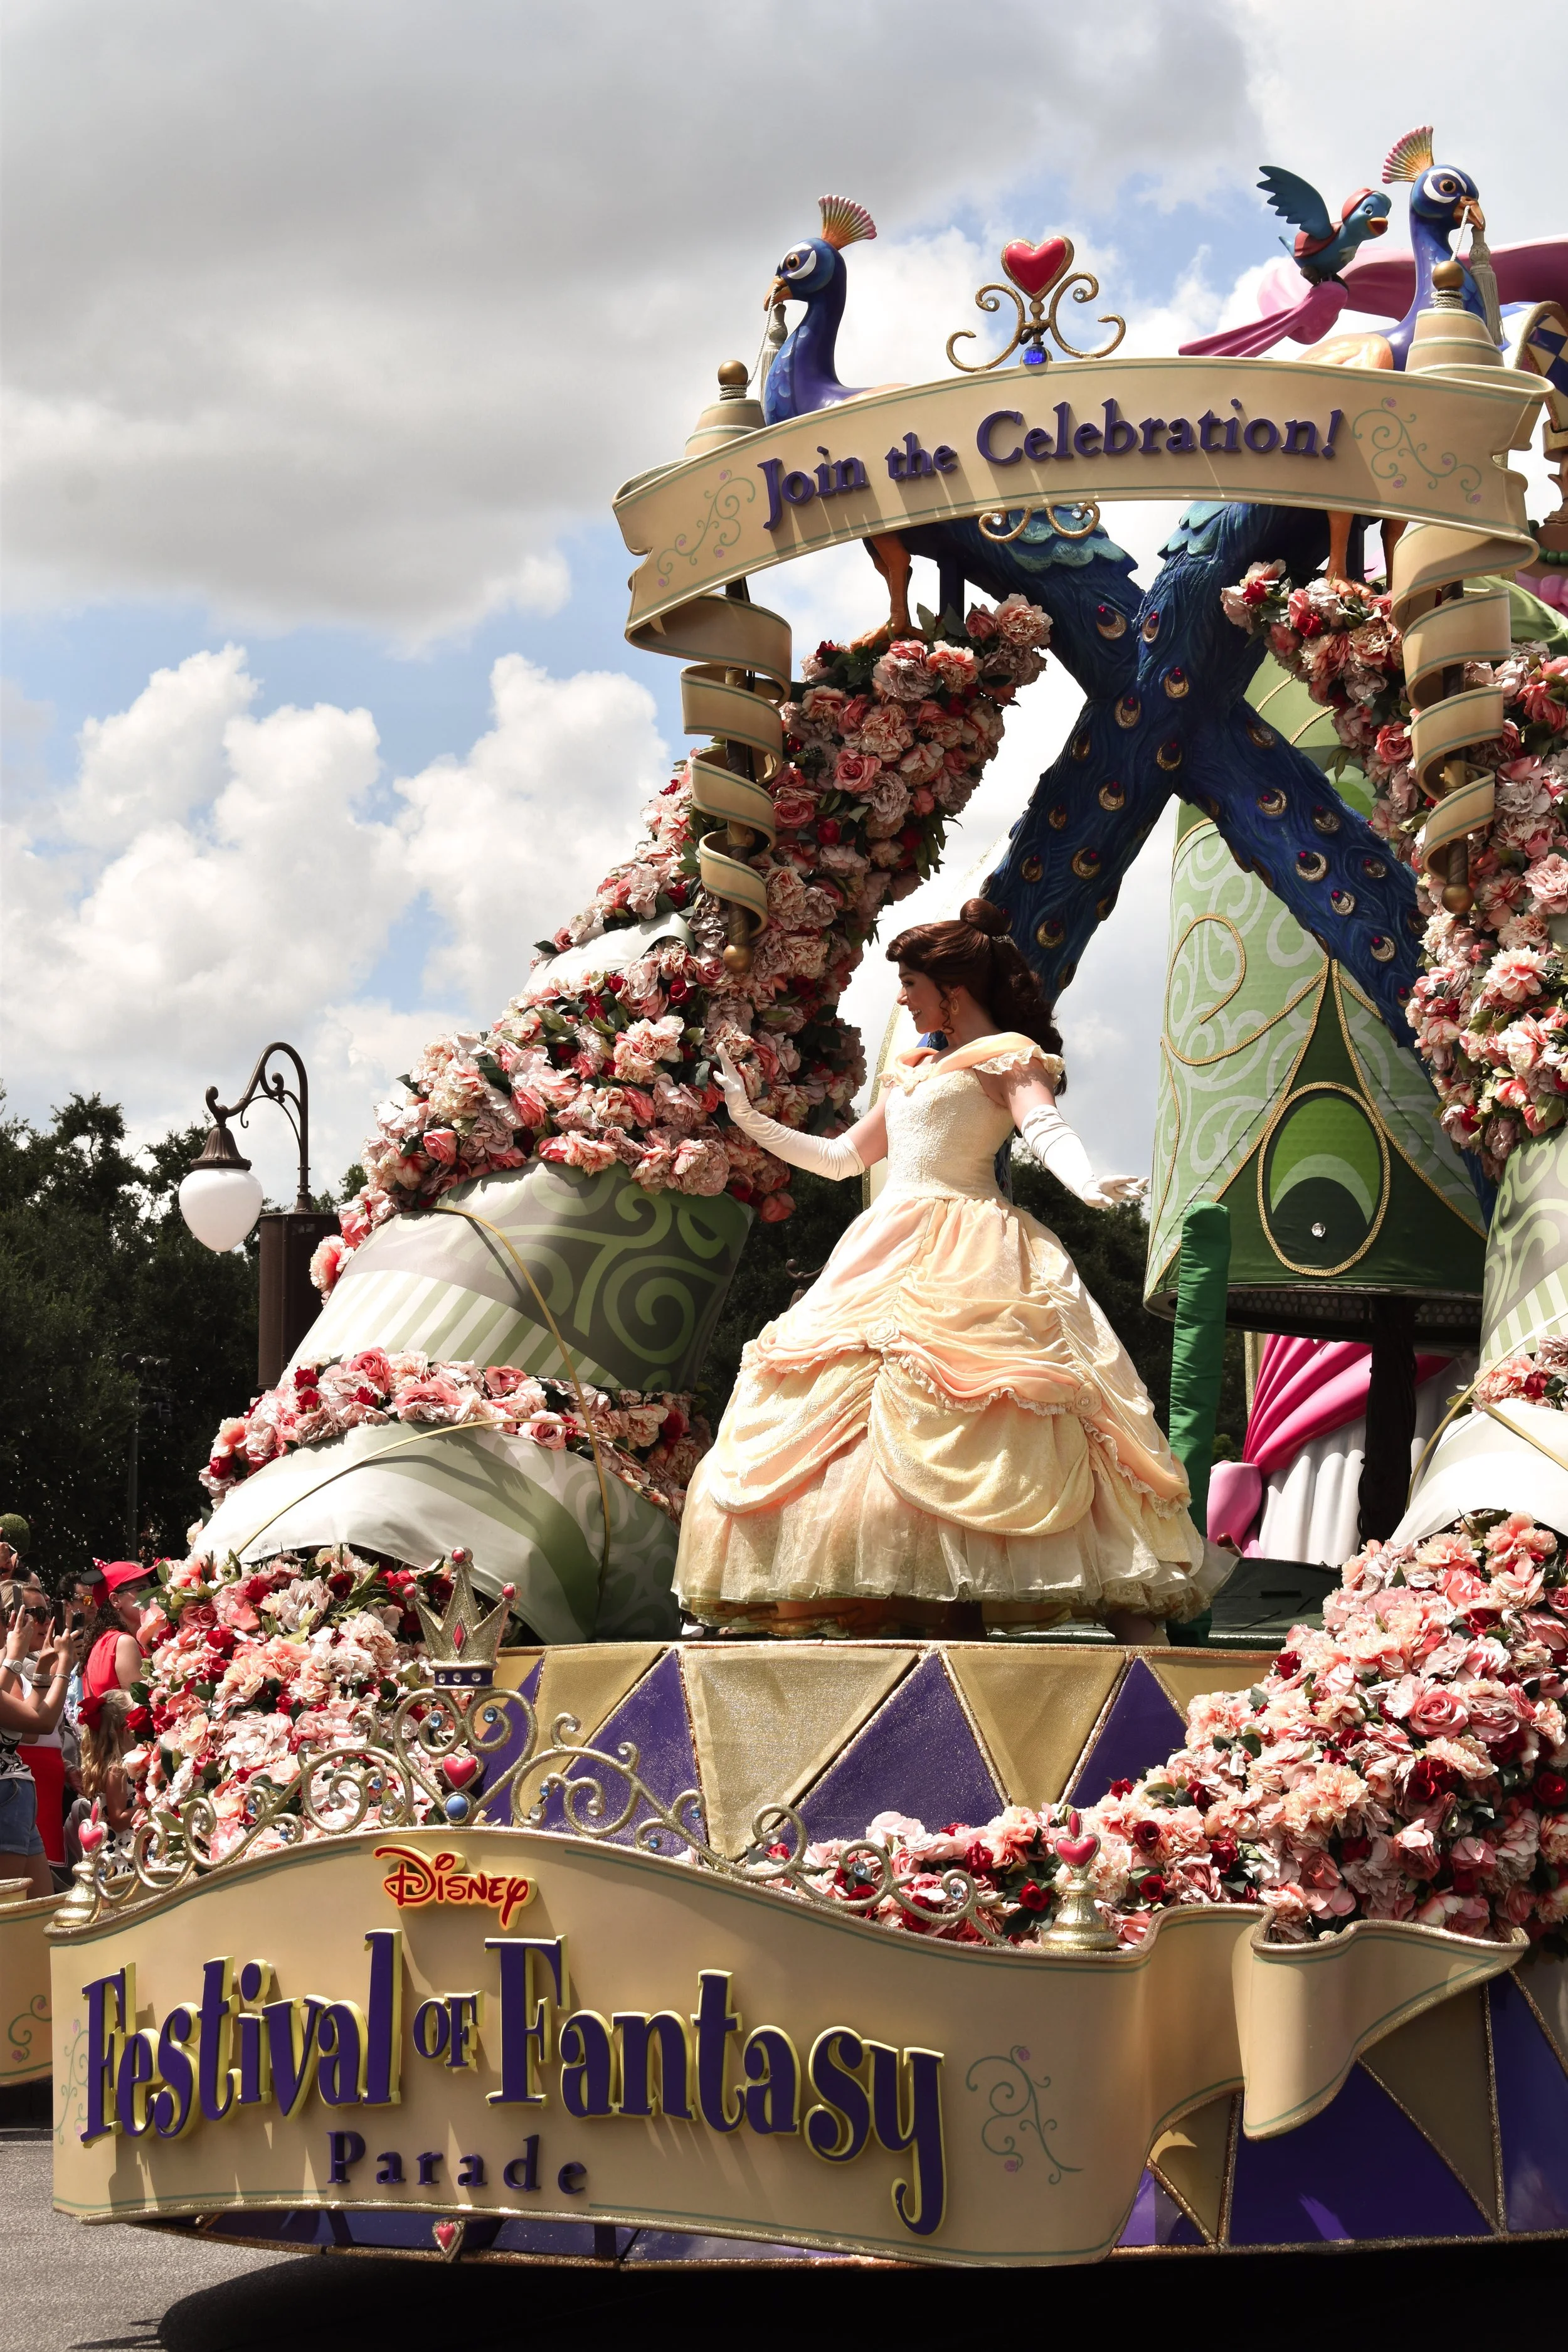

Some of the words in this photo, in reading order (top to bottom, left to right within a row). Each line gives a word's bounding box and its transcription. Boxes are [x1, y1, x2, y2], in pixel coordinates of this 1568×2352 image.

[758, 447, 867, 531] Join
[886, 430, 956, 484] the
[975, 397, 1343, 467] Celebration!
[81, 1928, 403, 2148] Festival
[485, 1935, 946, 2235] Fantasy
[327, 2130, 587, 2194] Parade
